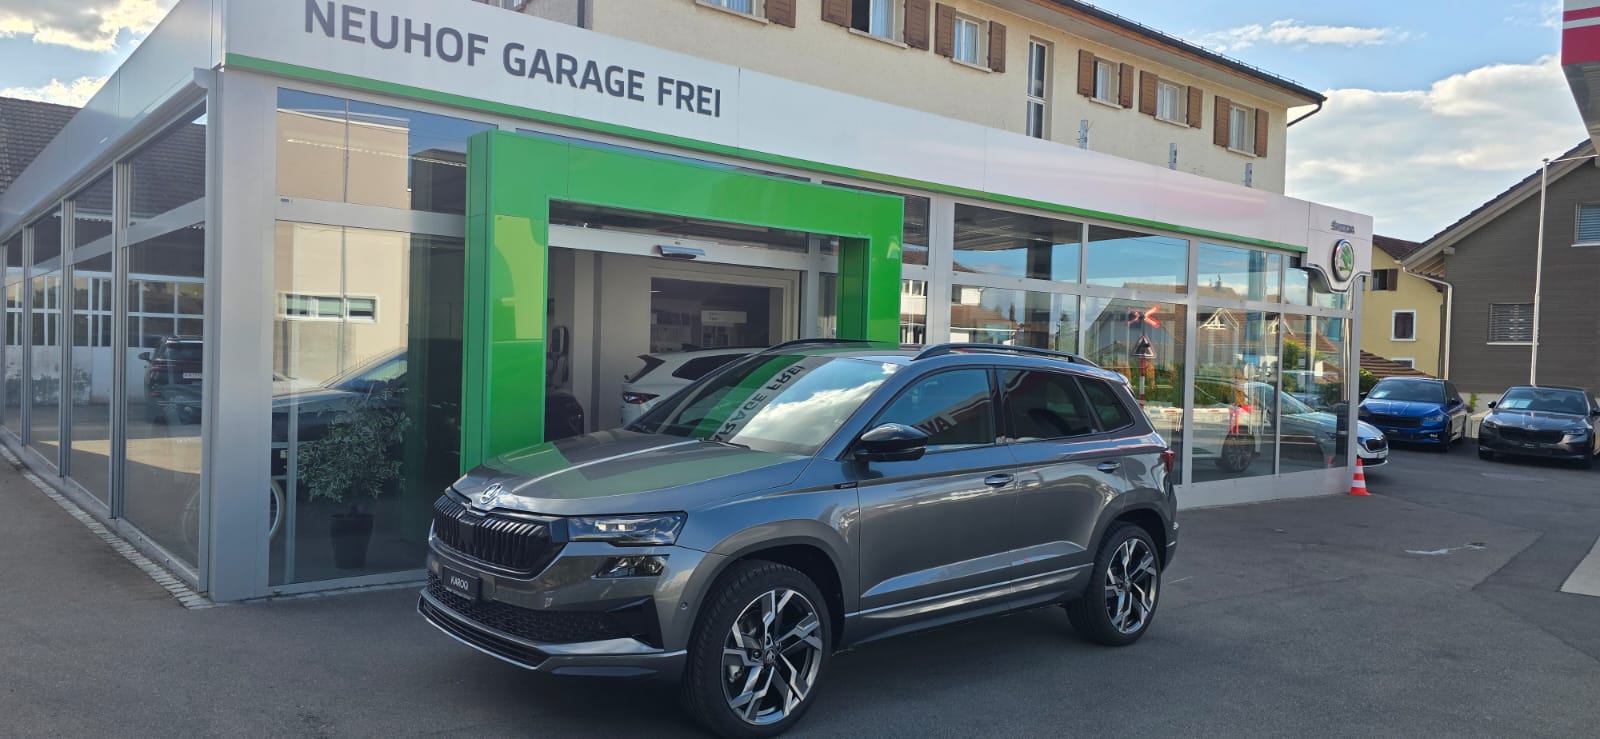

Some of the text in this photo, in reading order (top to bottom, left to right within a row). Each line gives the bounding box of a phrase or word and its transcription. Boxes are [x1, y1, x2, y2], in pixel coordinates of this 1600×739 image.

[305, 0, 721, 117] NEUHOF GARAGE FREI
